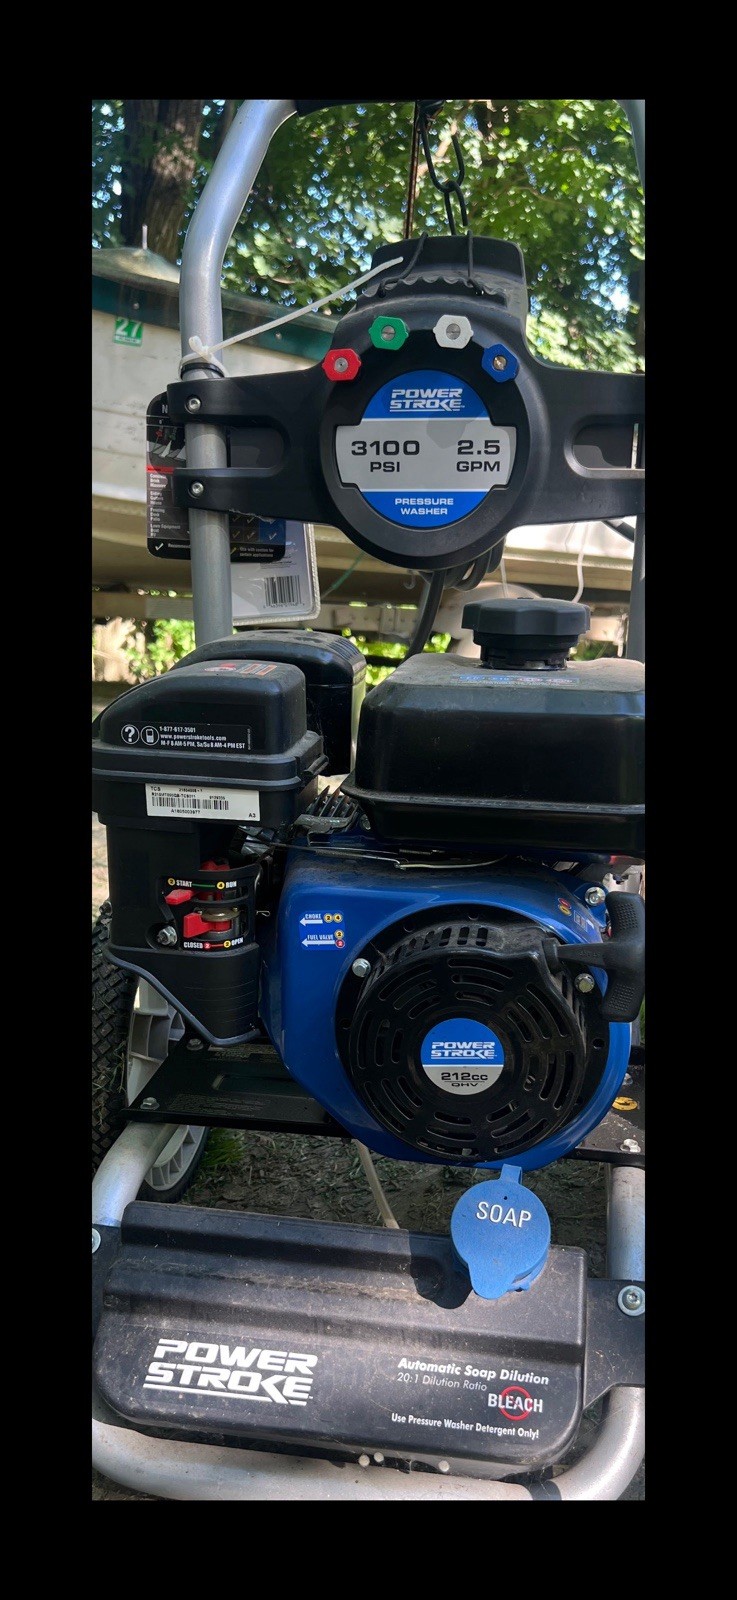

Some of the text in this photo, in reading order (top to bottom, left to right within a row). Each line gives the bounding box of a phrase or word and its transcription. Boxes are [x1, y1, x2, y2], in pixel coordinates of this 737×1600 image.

[115, 317, 141, 338] 27
[392, 388, 463, 398] POWER
[390, 399, 463, 411] STROKE
[351, 439, 501, 456] 3100 2.5
[370, 460, 500, 473] PSI GPM
[395, 498, 454, 506] PRESSURE
[231, 937, 244, 946] OPEN
[431, 1041, 496, 1049] POWER
[431, 1049, 495, 1059] STROKE
[441, 1072, 488, 1081] 212cc
[476, 1201, 532, 1228] SOAP
[153, 1338, 318, 1375] POWER
[397, 1357, 549, 1385] Automatic Soap Dilution
[145, 1361, 314, 1405] STROKE
[396, 1372, 488, 1391] 20:1 Dilution Ratio
[487, 1393, 544, 1413] BLEACH
[391, 1412, 540, 1440] Use Pressure Washer Detergent Only!
